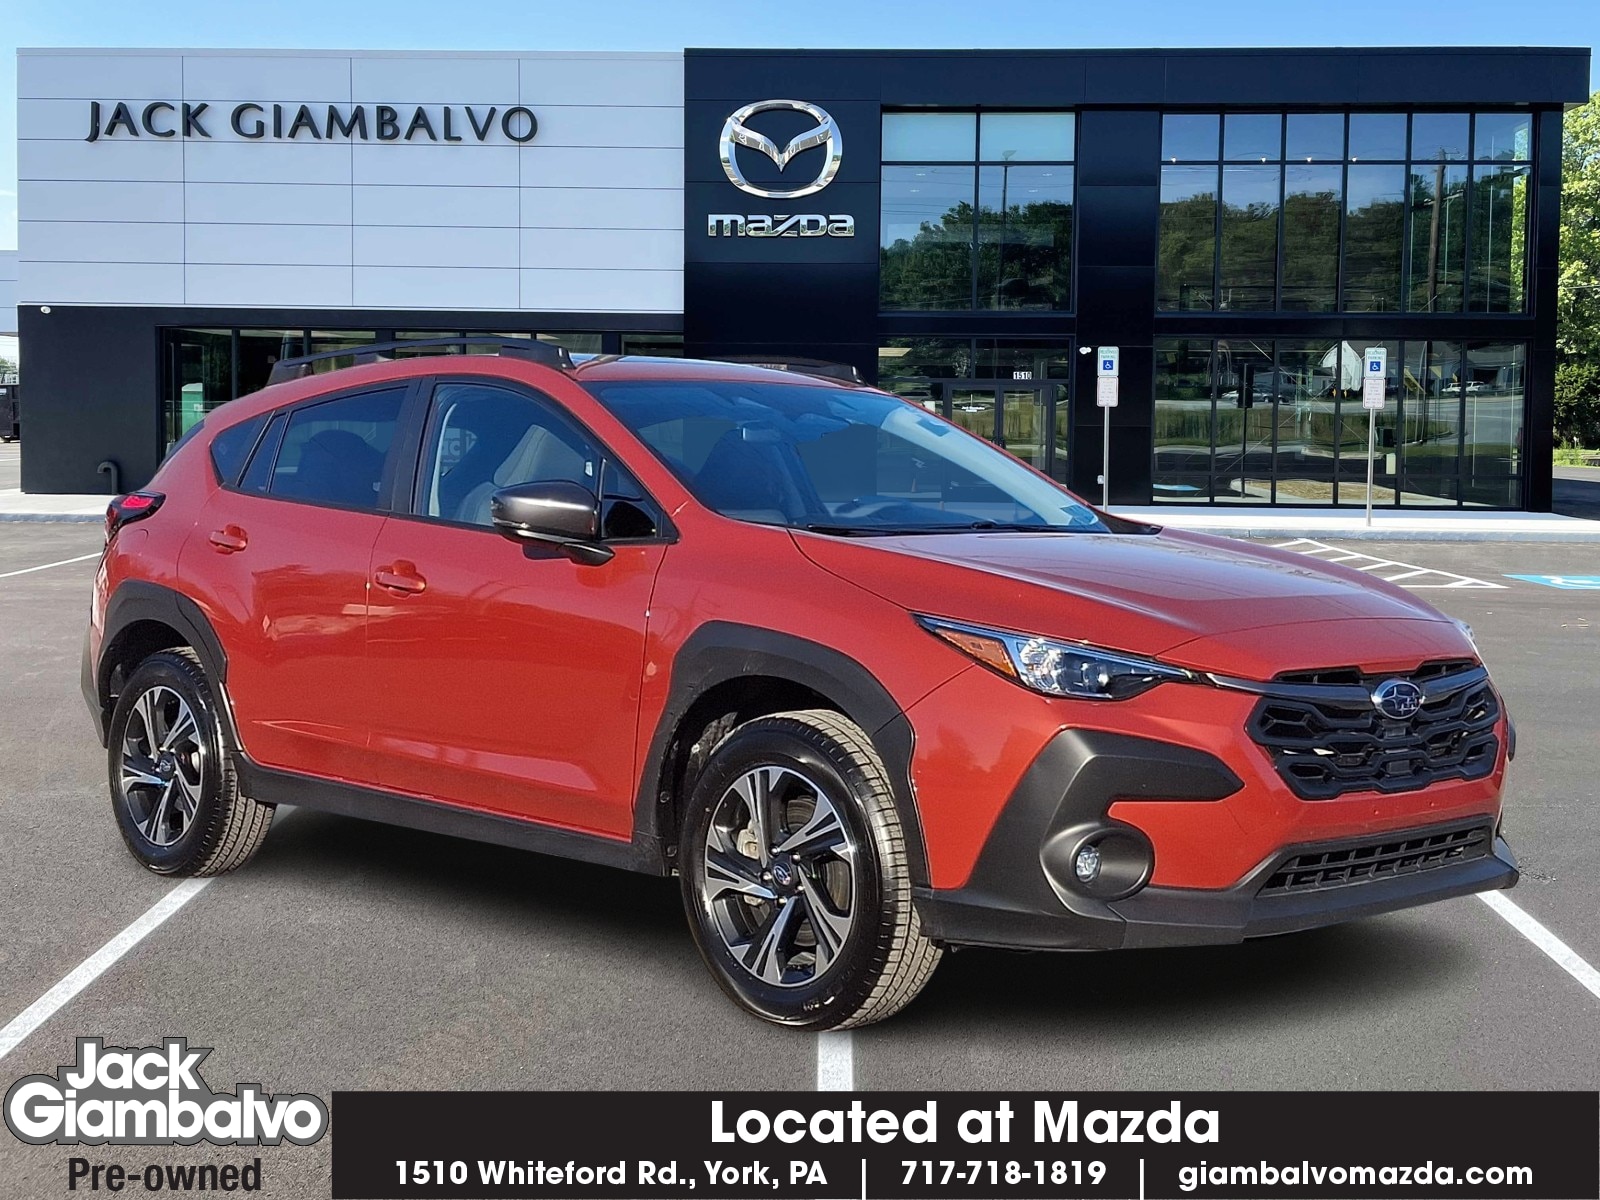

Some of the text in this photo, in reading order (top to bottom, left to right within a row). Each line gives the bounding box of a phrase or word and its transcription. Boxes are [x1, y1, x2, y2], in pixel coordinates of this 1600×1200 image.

[85, 101, 538, 142] JACK GIAMBALVO
[707, 214, 855, 237] mazda
[1013, 371, 1032, 380] 1510
